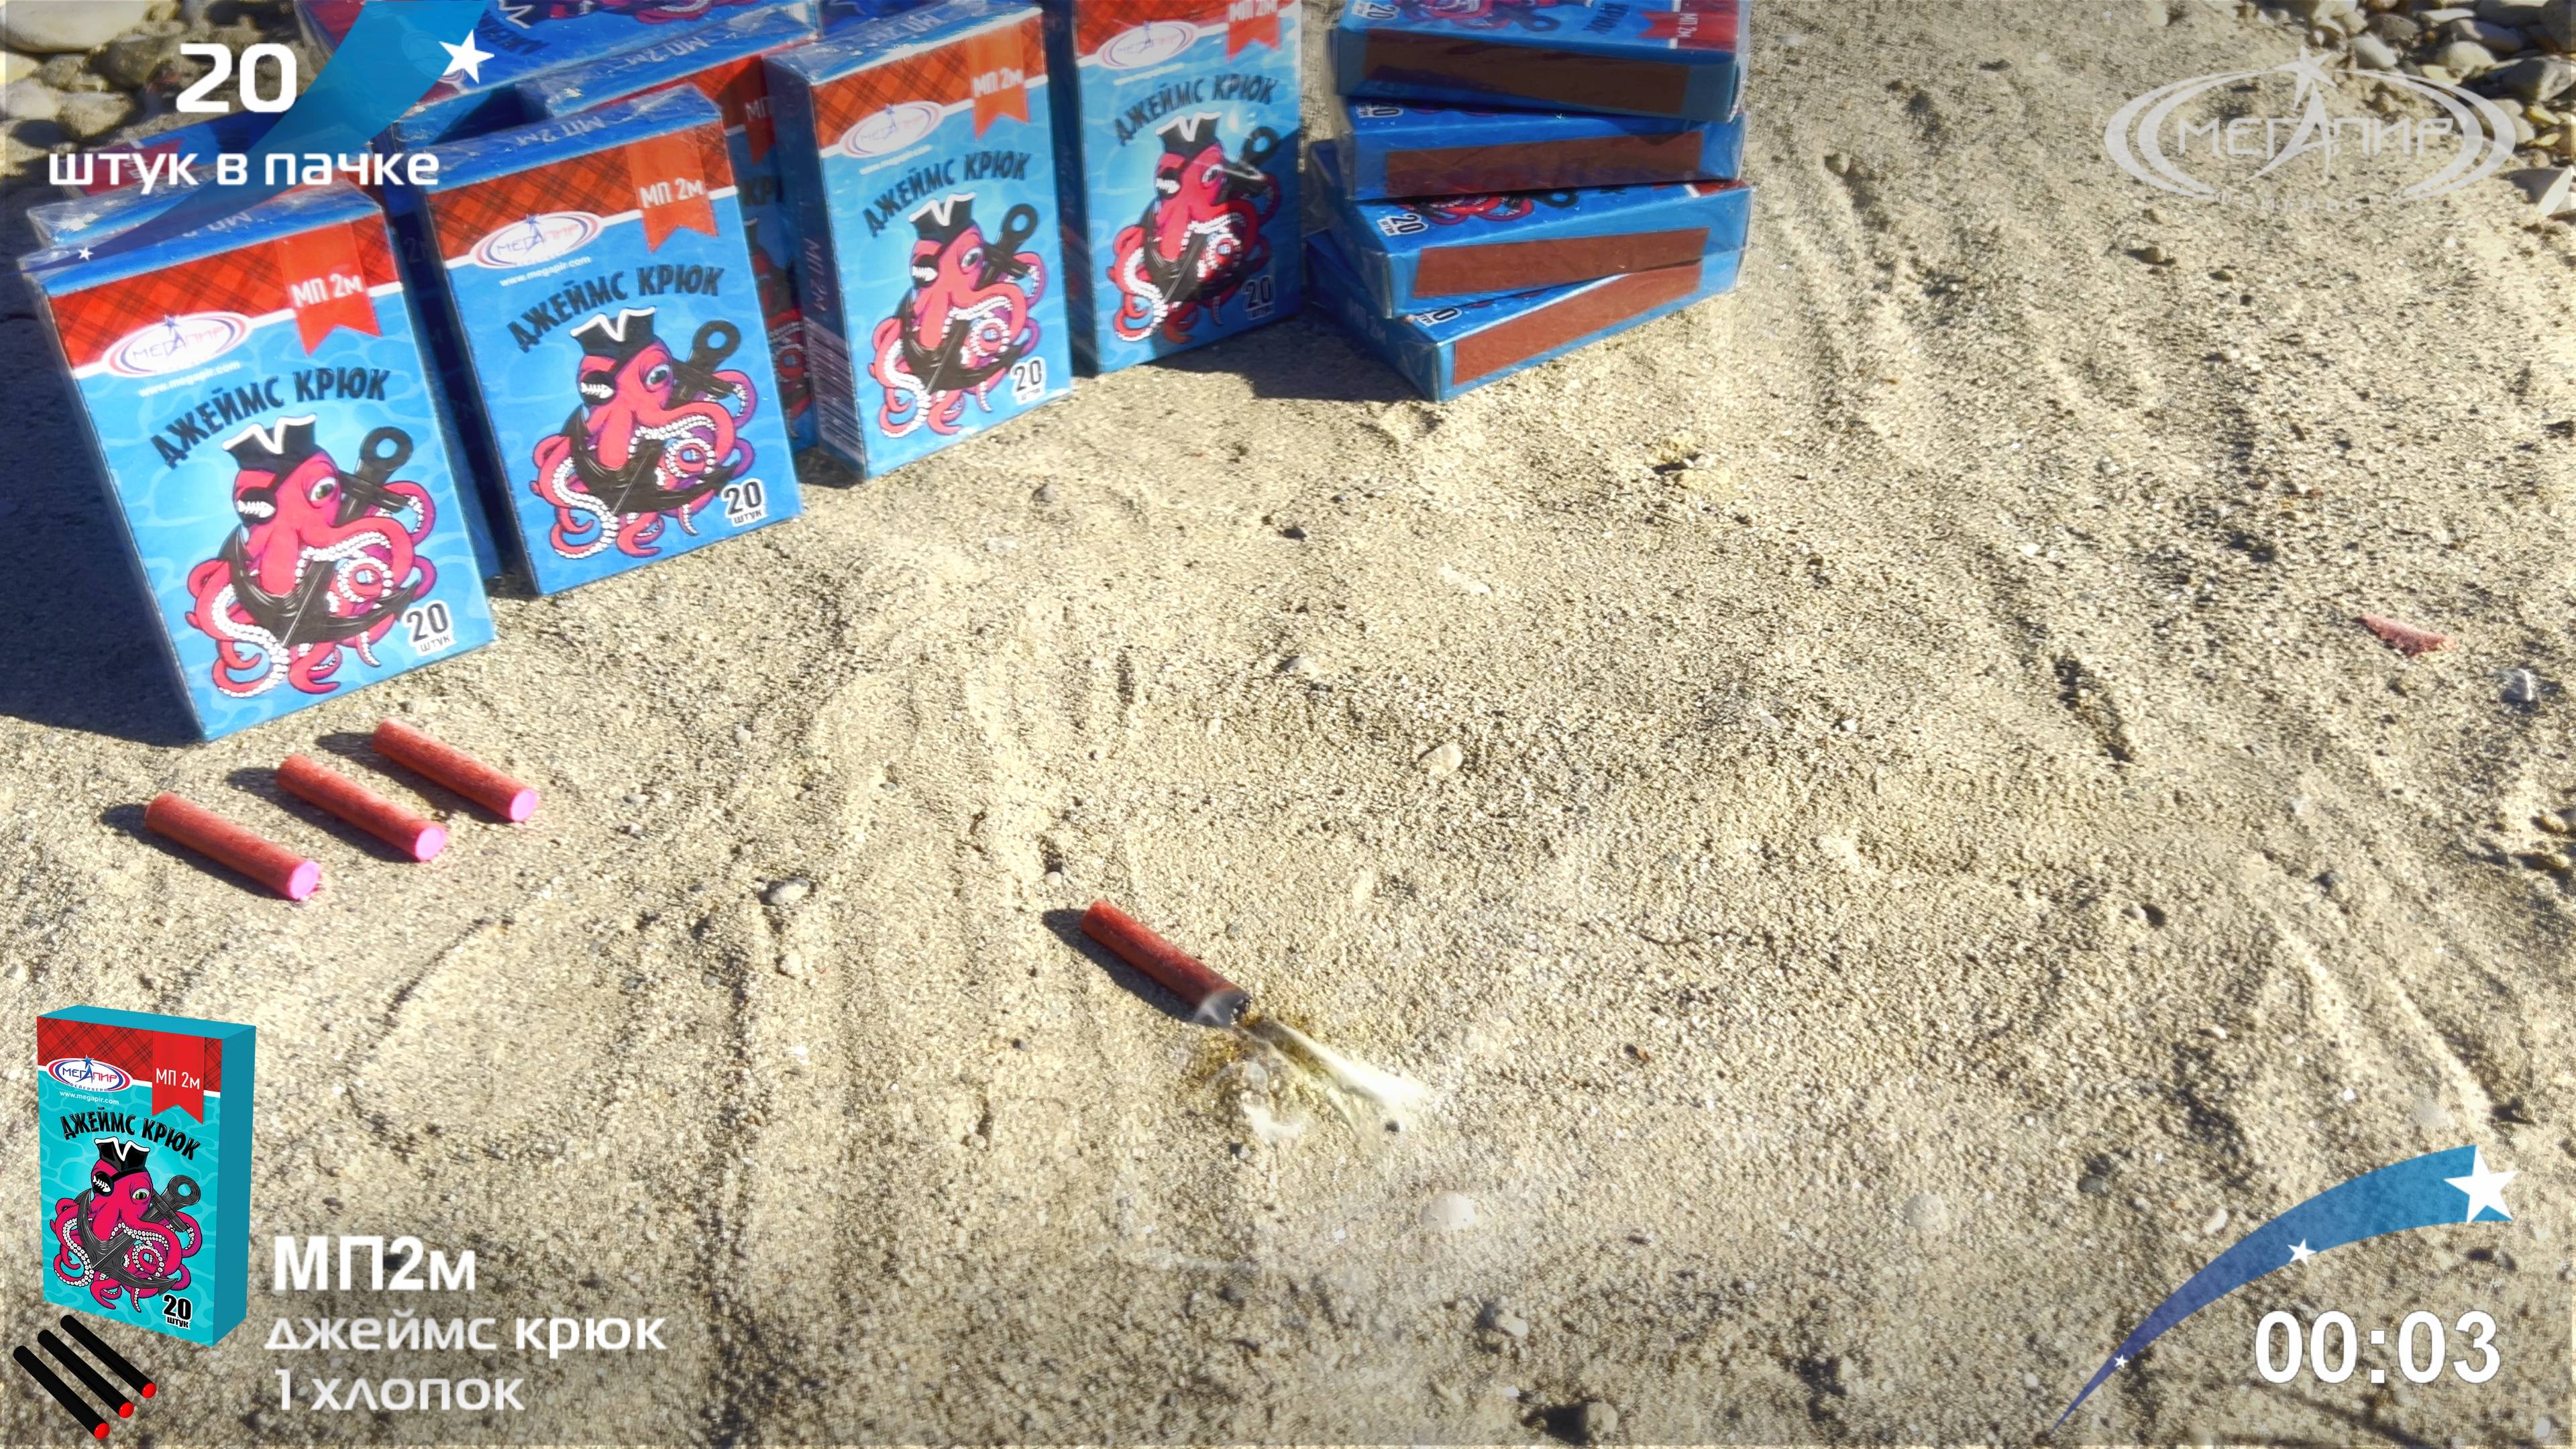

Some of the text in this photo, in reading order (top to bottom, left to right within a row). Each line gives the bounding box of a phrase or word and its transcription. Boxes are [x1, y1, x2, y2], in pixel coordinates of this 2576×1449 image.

[973, 71, 998, 97] МП
[1114, 78, 1204, 146] ДЖЕЙМС
[1212, 73, 1278, 105] КРЮК
[639, 177, 705, 209] МП 2м
[863, 157, 955, 237] ДЖЕЙМС
[964, 150, 1032, 181] КРЮК
[1391, 215, 1424, 233] 20
[290, 273, 364, 308] МП 2м
[506, 264, 724, 353] ДЖЕЙМС КРЮК
[1014, 360, 1042, 392] 20
[151, 367, 390, 470] ДЖЕЙМС КРЮК
[724, 482, 761, 515] 20
[407, 603, 448, 642] 20
